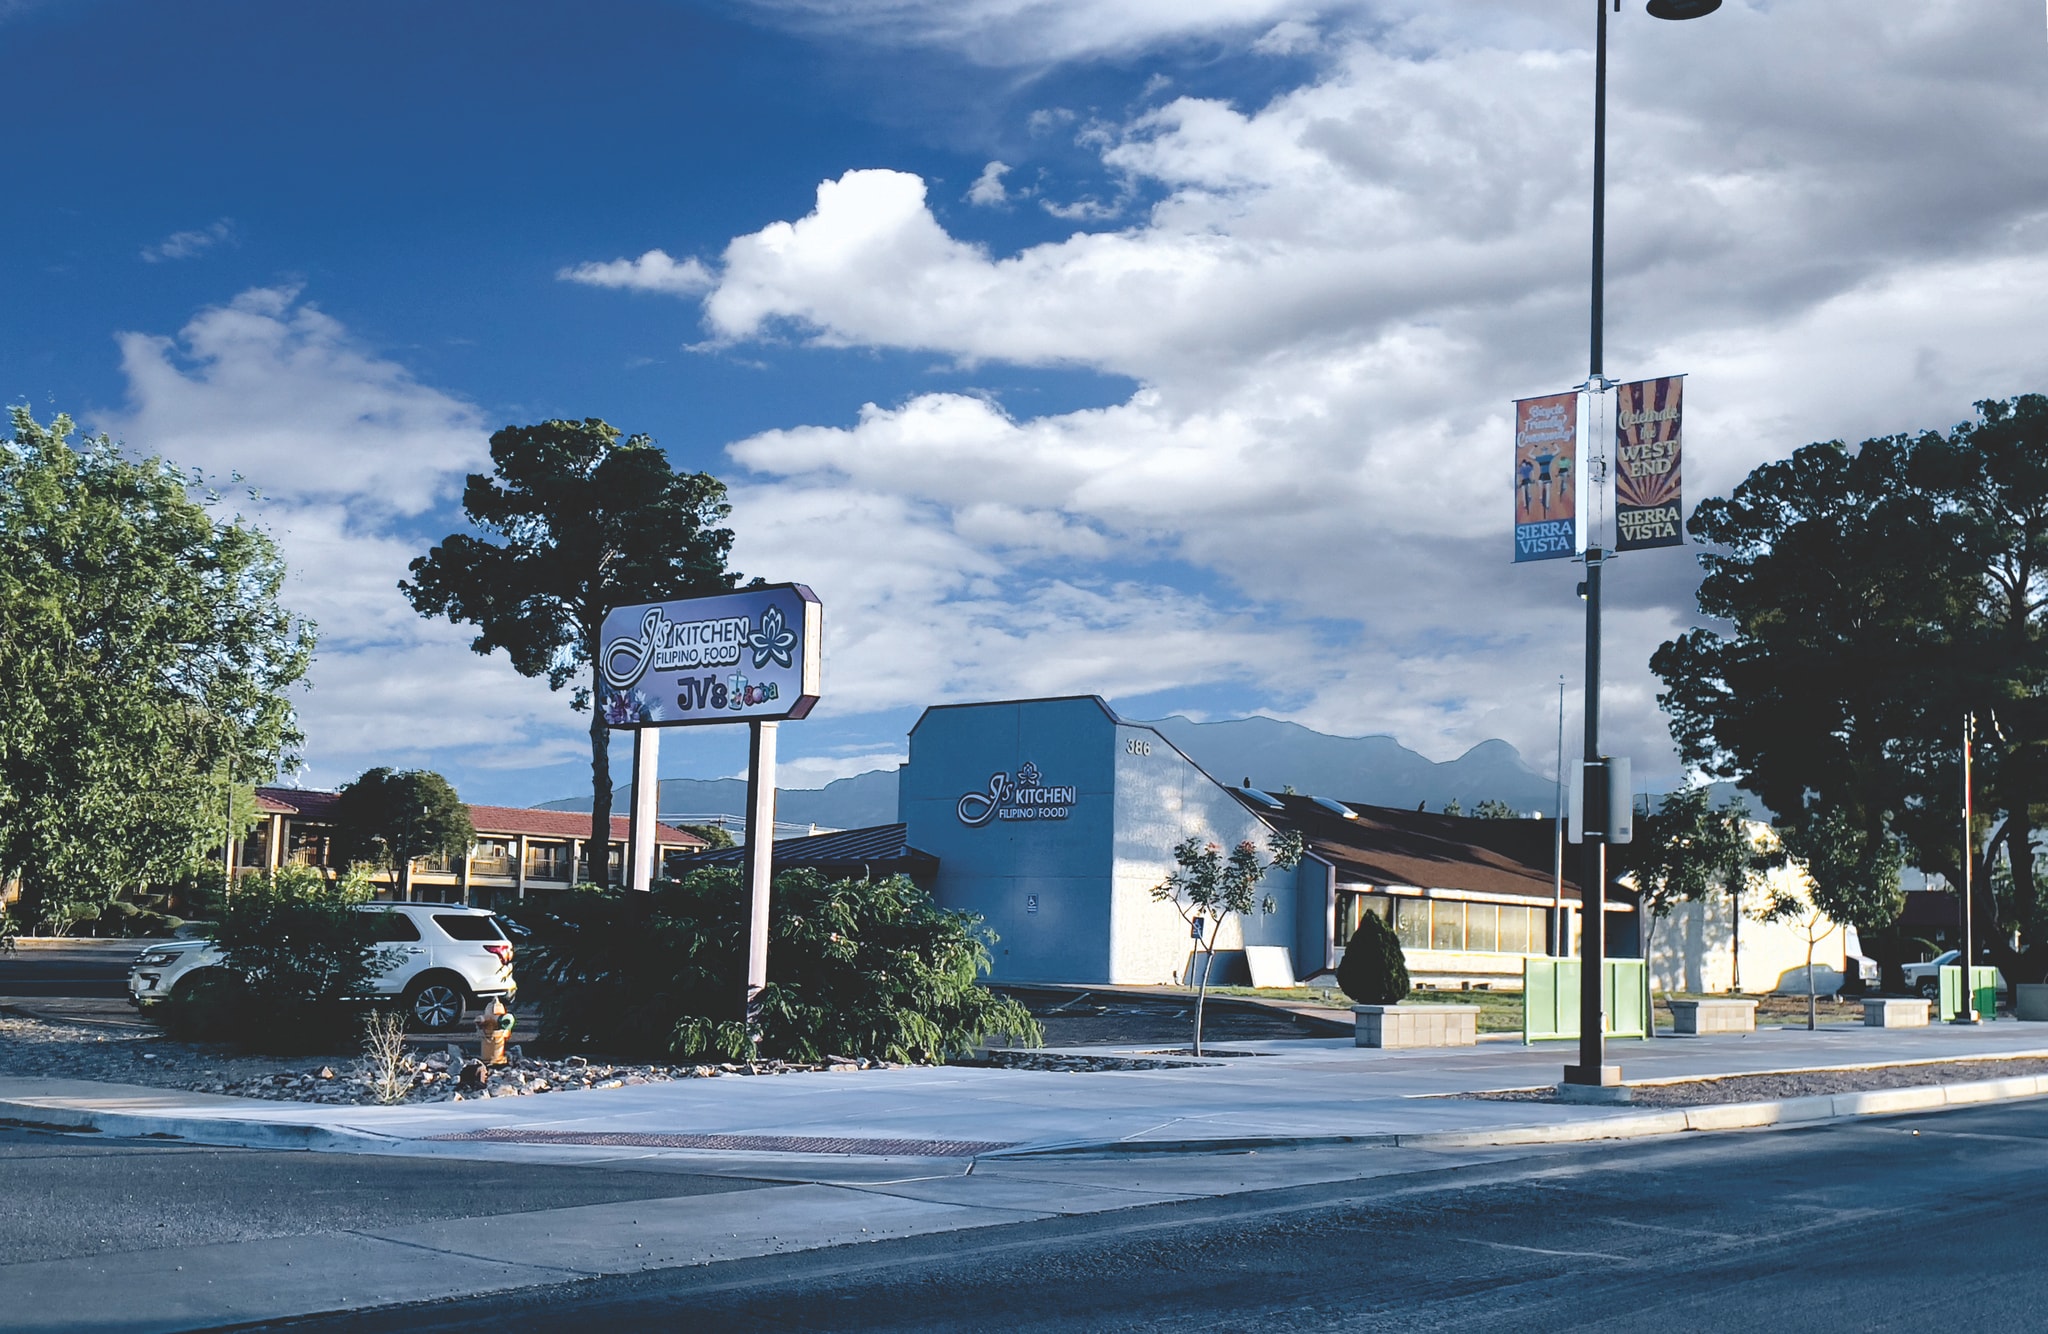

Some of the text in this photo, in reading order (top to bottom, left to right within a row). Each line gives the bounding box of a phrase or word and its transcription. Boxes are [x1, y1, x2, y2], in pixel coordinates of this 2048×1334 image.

[1618, 406, 1680, 430] Celebrate
[1621, 439, 1677, 461] WEST
[1630, 458, 1672, 478] END
[1618, 507, 1680, 527] SIERRA
[1516, 521, 1573, 541] SIERRA
[1621, 522, 1677, 541] VISTA
[1520, 536, 1570, 554] VISTA
[674, 618, 748, 646] KITCHEN
[655, 644, 737, 666] FILIPINO FOOD
[1126, 738, 1151, 757] 386
[1015, 786, 1073, 804] KITCHEN
[999, 806, 1066, 819] FILIPINO FOOD
